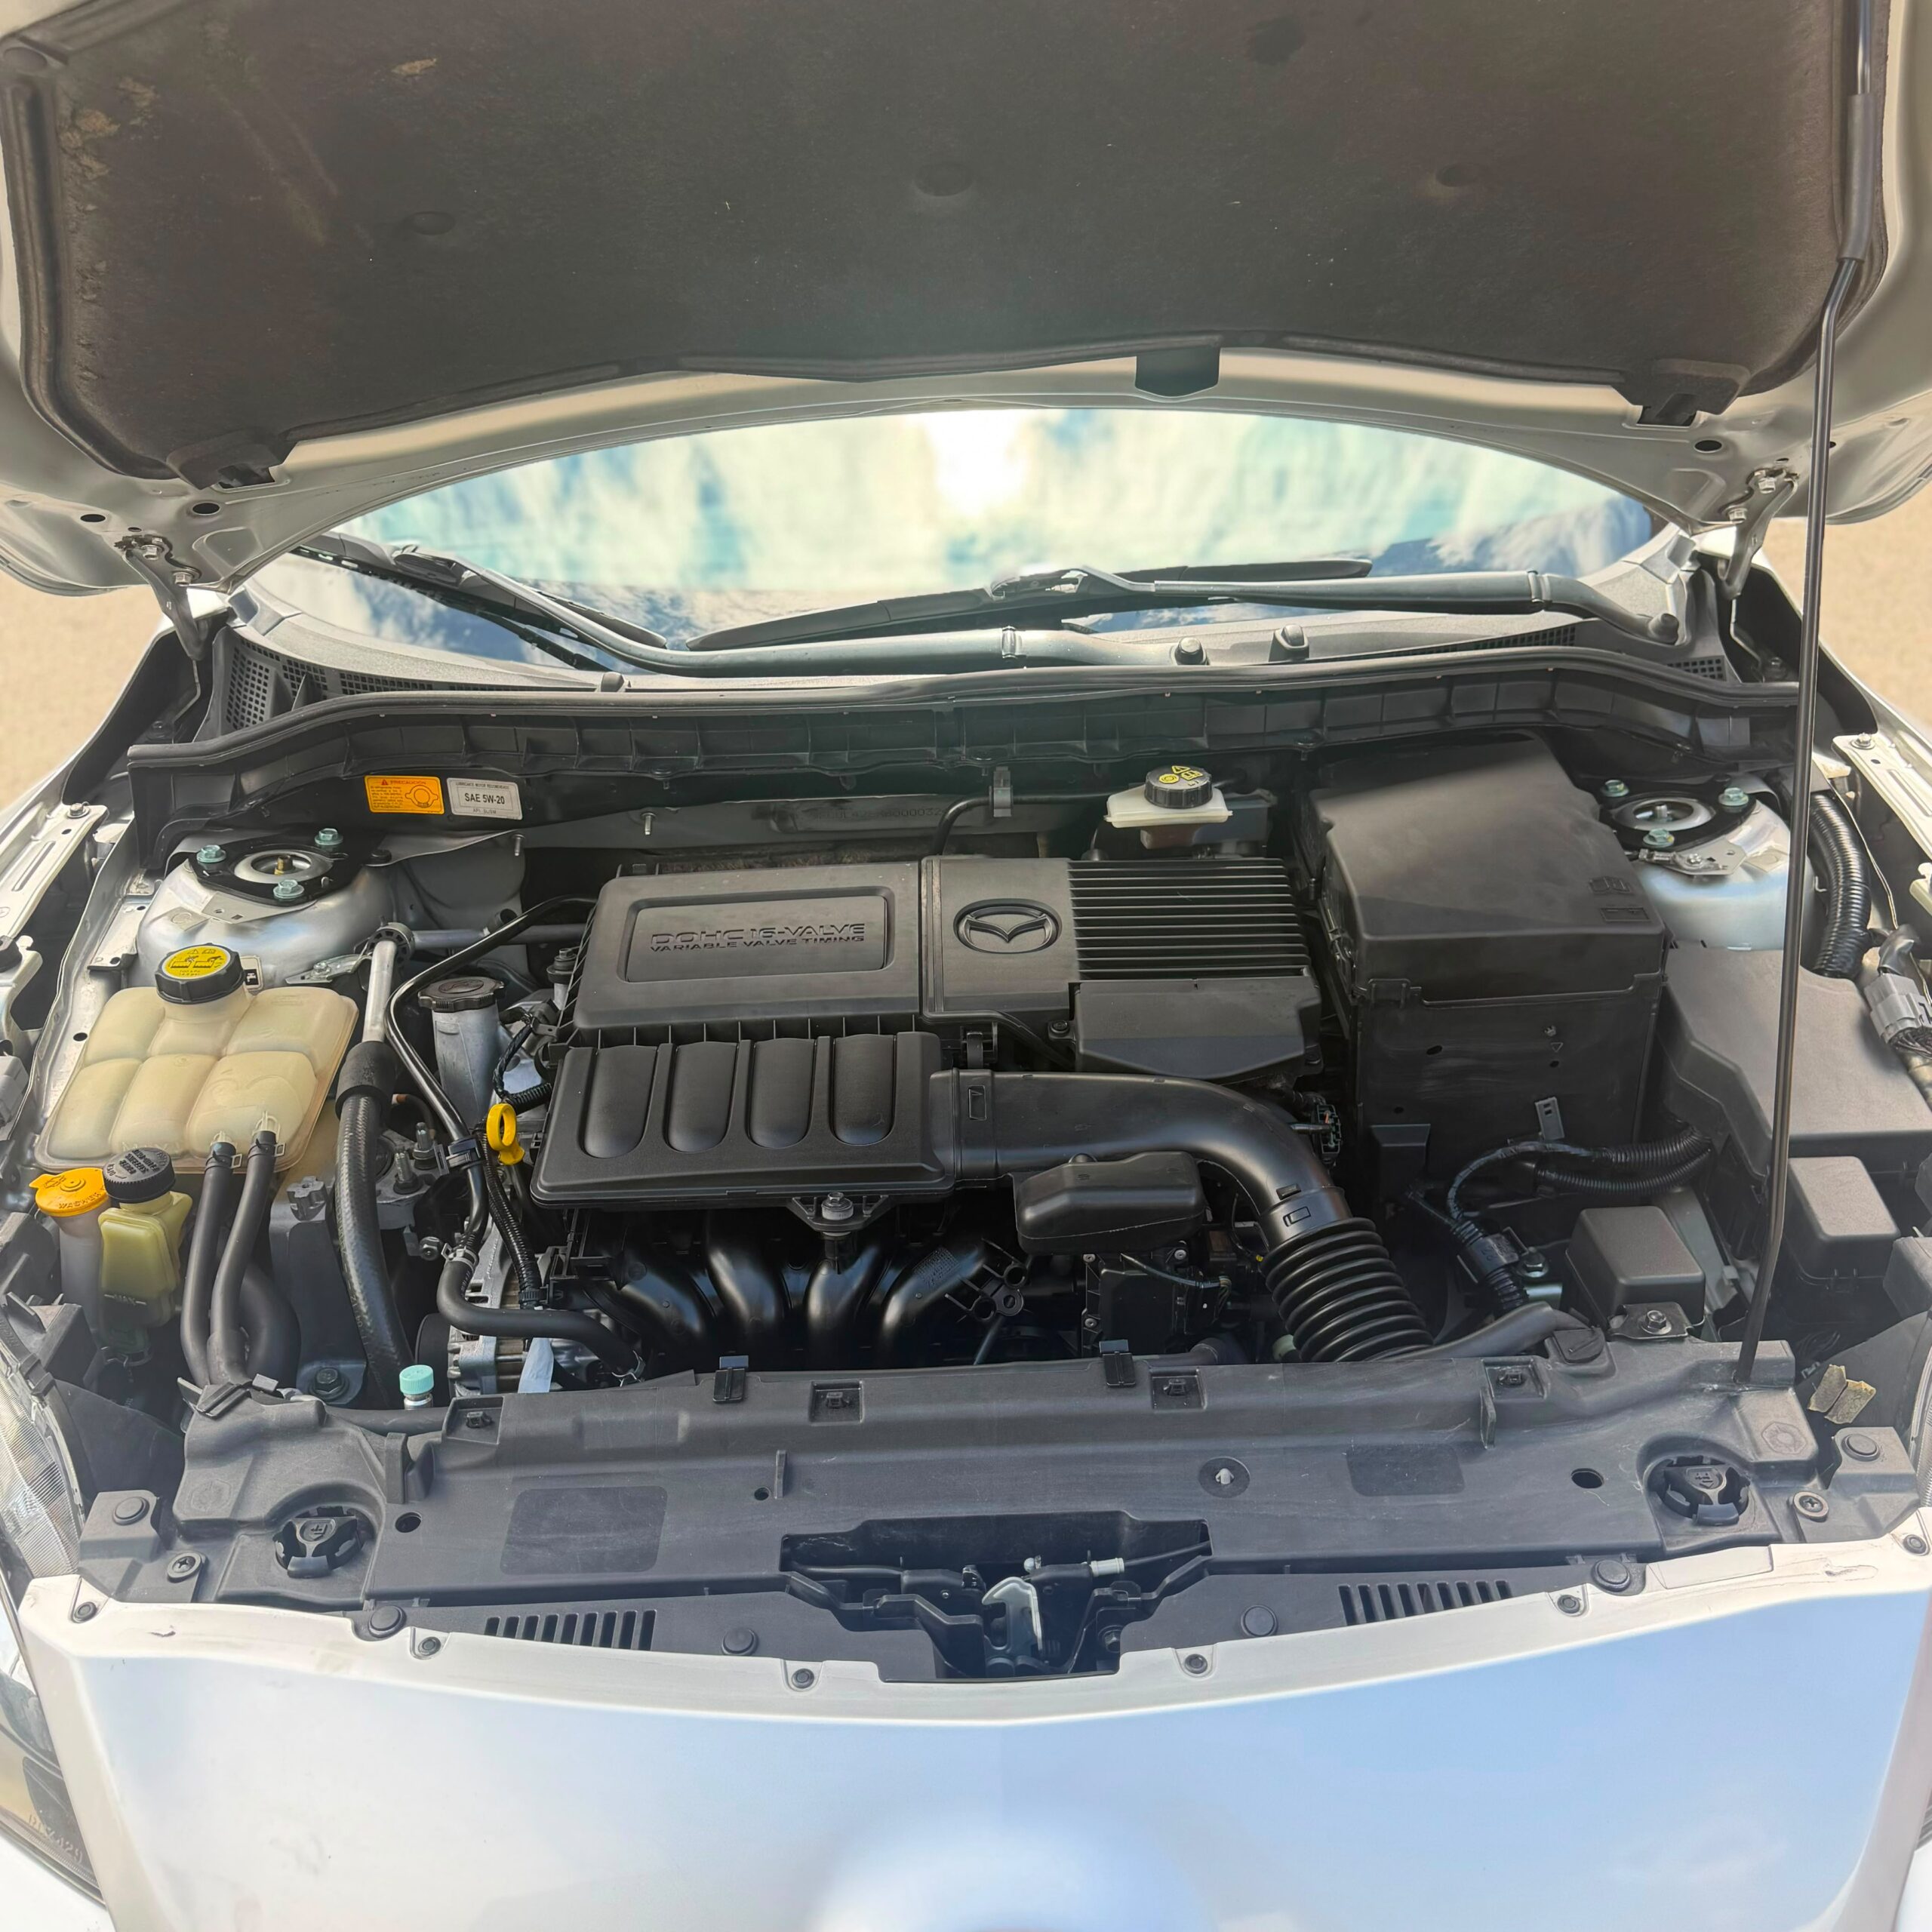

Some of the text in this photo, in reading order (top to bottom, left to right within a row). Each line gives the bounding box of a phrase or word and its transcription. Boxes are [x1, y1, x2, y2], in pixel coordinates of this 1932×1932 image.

[464, 792, 505, 804] SAE 5W-20
[651, 923, 866, 945] DOHC 16-VALVE
[650, 935, 865, 952] VARIABLE VALVE TIMING
